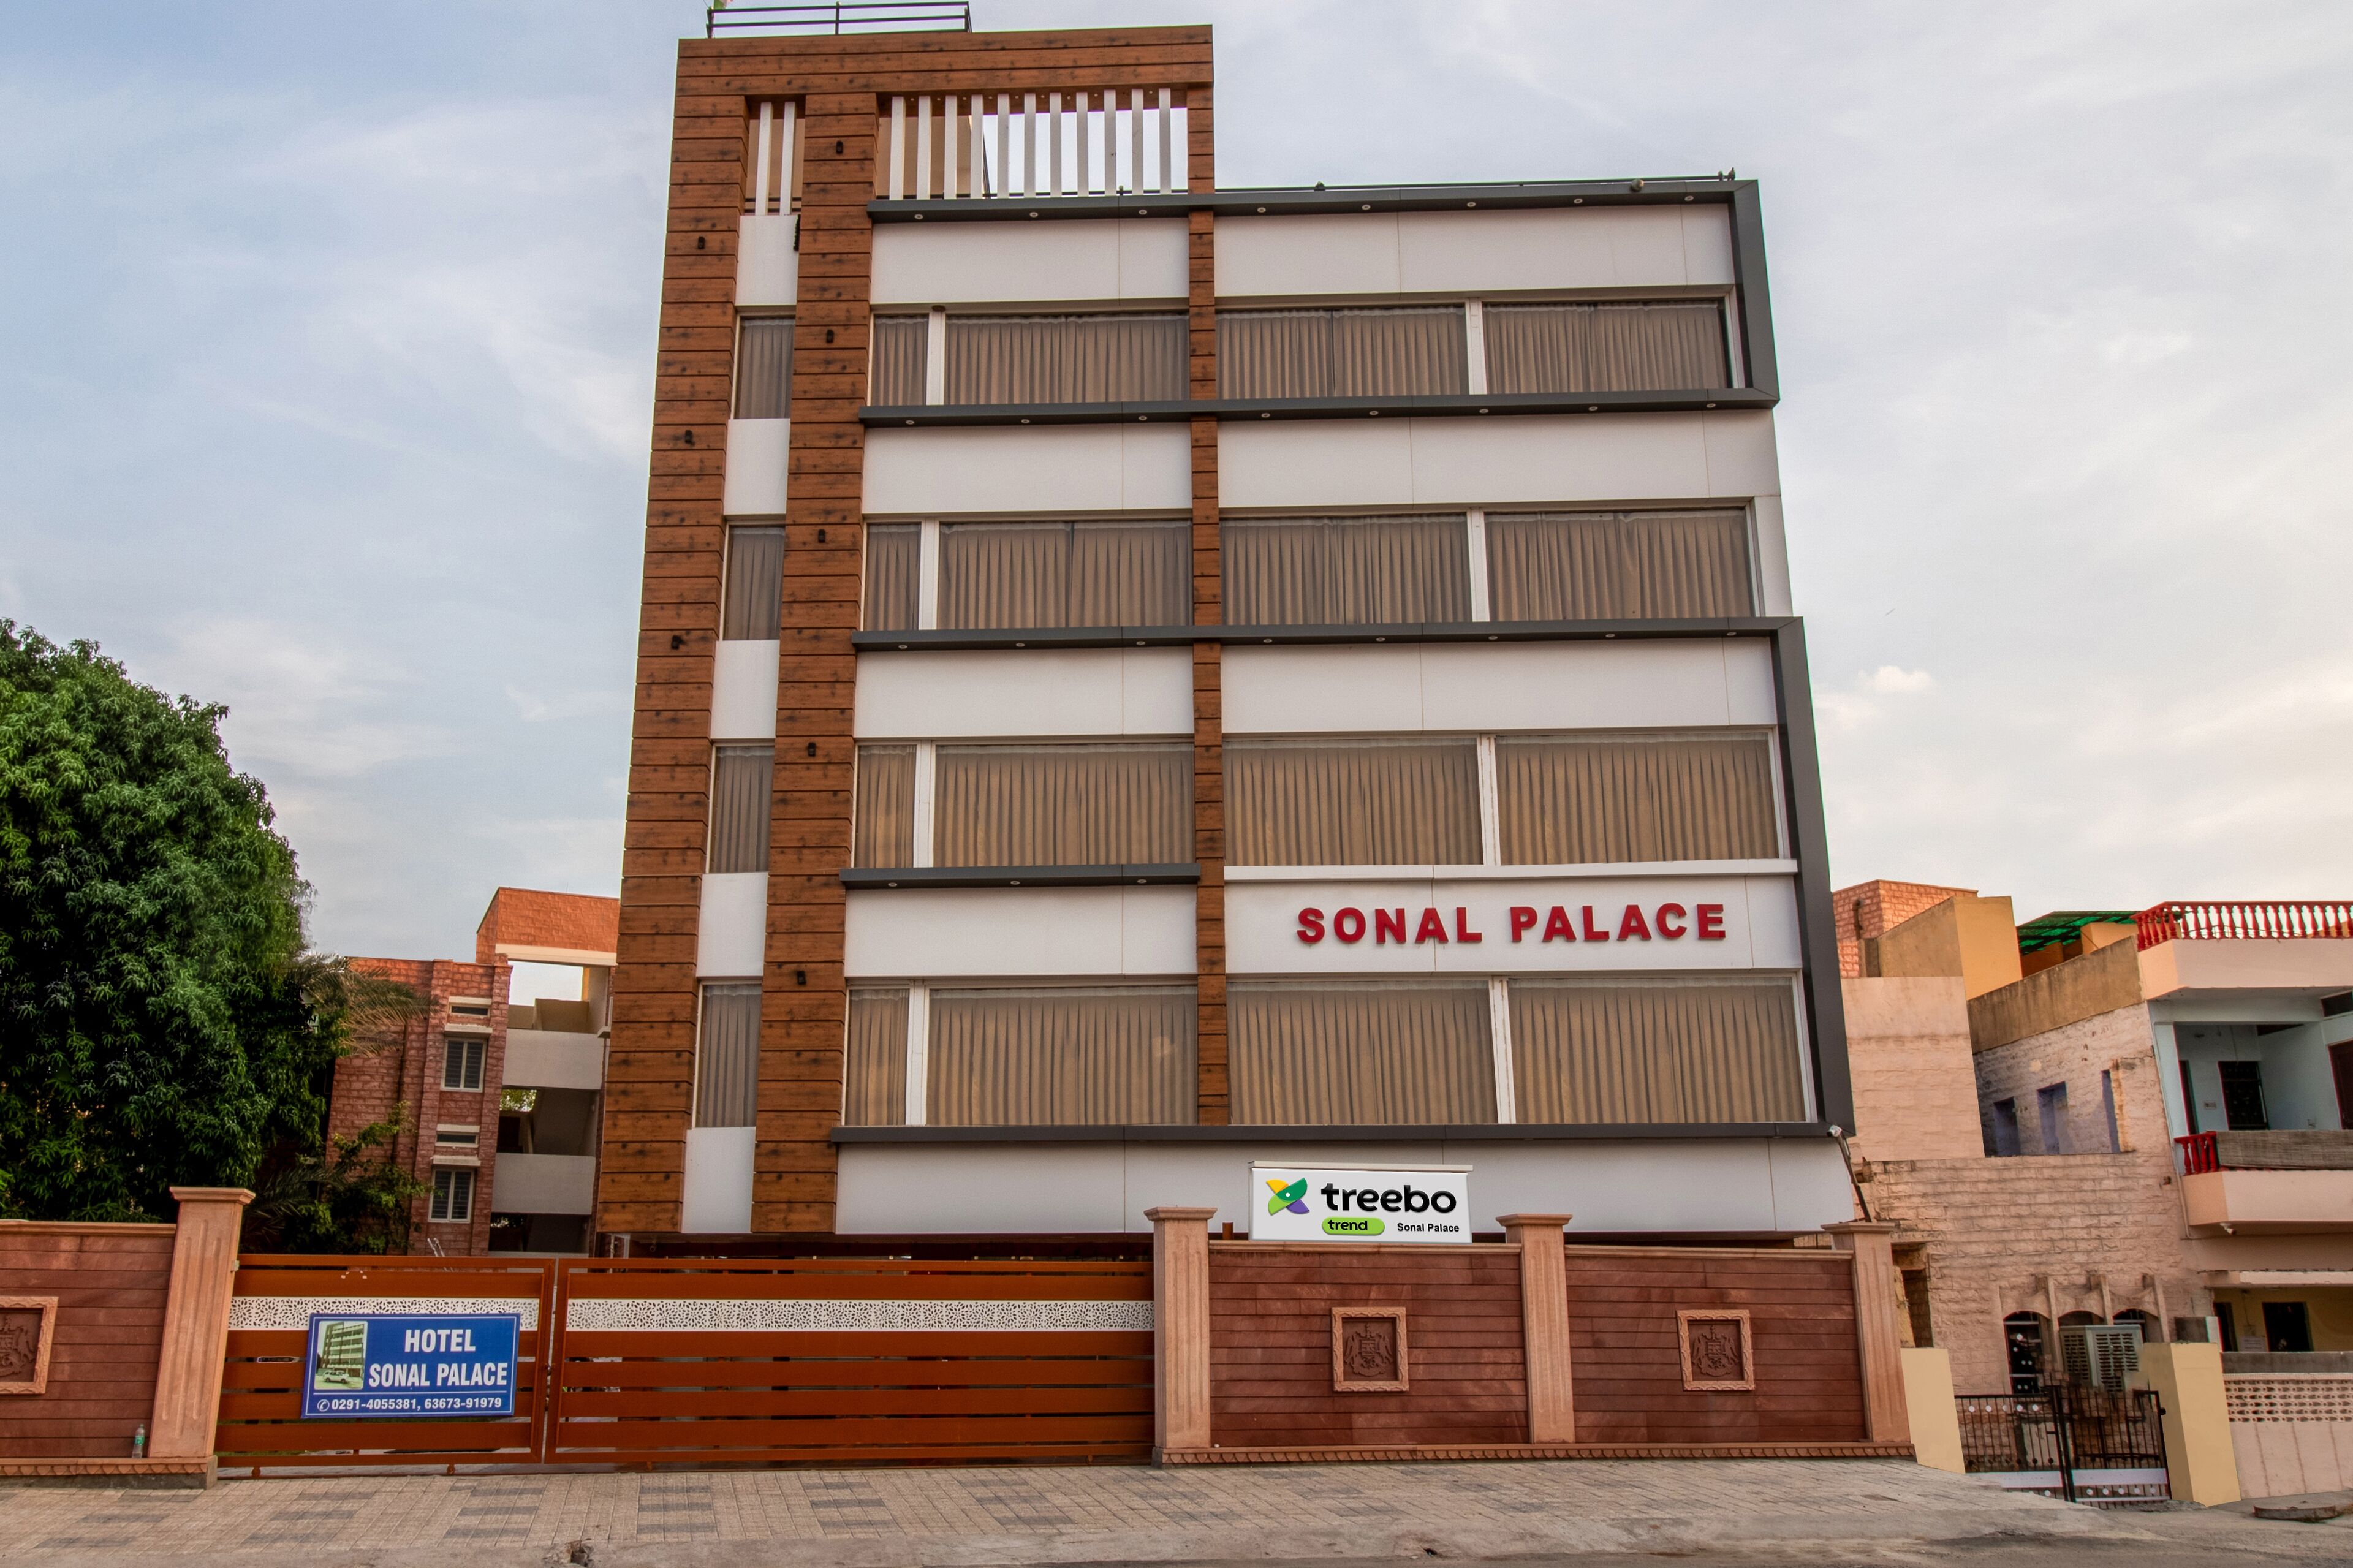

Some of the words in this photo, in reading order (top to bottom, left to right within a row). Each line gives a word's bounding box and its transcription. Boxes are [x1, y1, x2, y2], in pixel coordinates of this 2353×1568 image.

[1296, 907, 1482, 944] SONAL
[1509, 903, 1726, 942] PALACE
[1320, 1183, 1457, 1213] treebo
[1327, 1219, 1368, 1232] trend
[1396, 1222, 1425, 1232] Sonal
[1427, 1223, 1460, 1233] Palace
[404, 1328, 476, 1353] HOTEL
[368, 1362, 430, 1388] SONAL
[436, 1362, 508, 1387] PALACE
[332, 1398, 421, 1411] 0291-4055381,
[424, 1397, 502, 1409] 63673-91979
